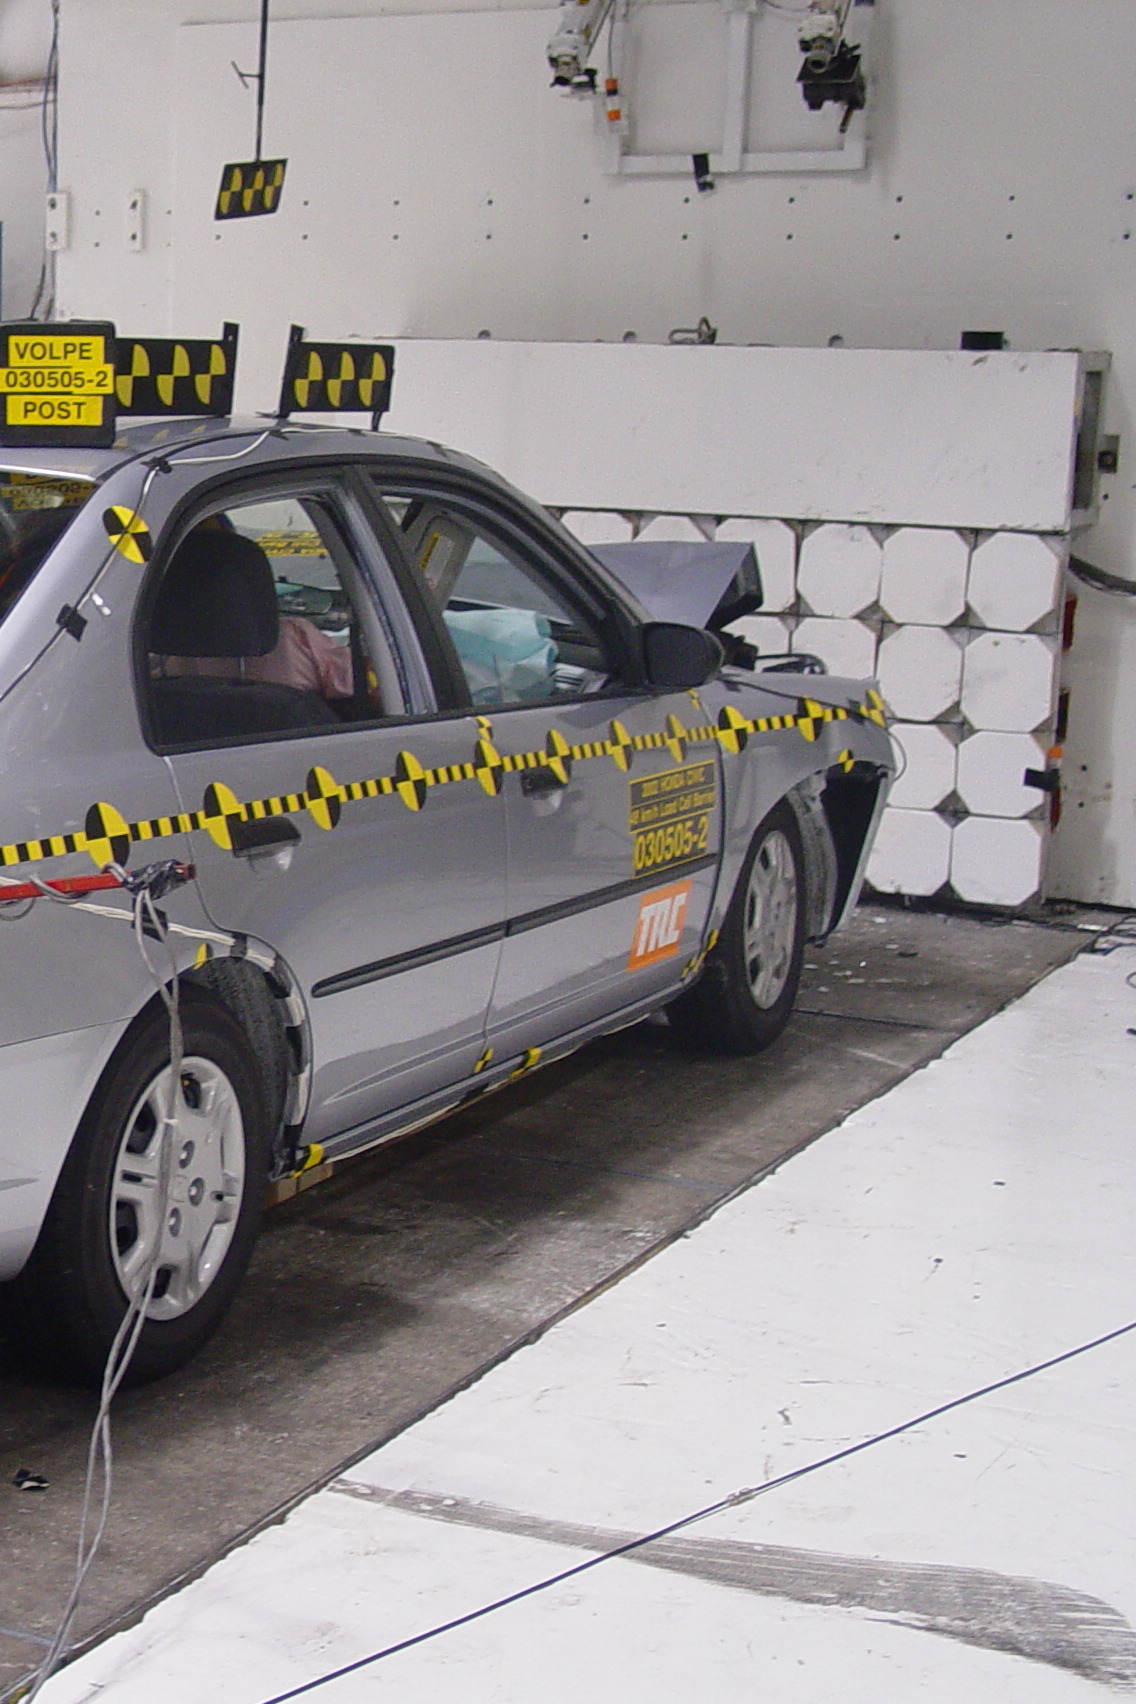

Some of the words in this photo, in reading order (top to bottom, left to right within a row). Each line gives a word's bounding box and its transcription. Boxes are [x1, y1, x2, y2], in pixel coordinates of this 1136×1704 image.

[14, 341, 93, 360] VOLPE
[5, 370, 108, 388] 030505-2
[23, 401, 86, 419] POST
[633, 814, 708, 870] 030505-2
[635, 891, 688, 957] TRC
